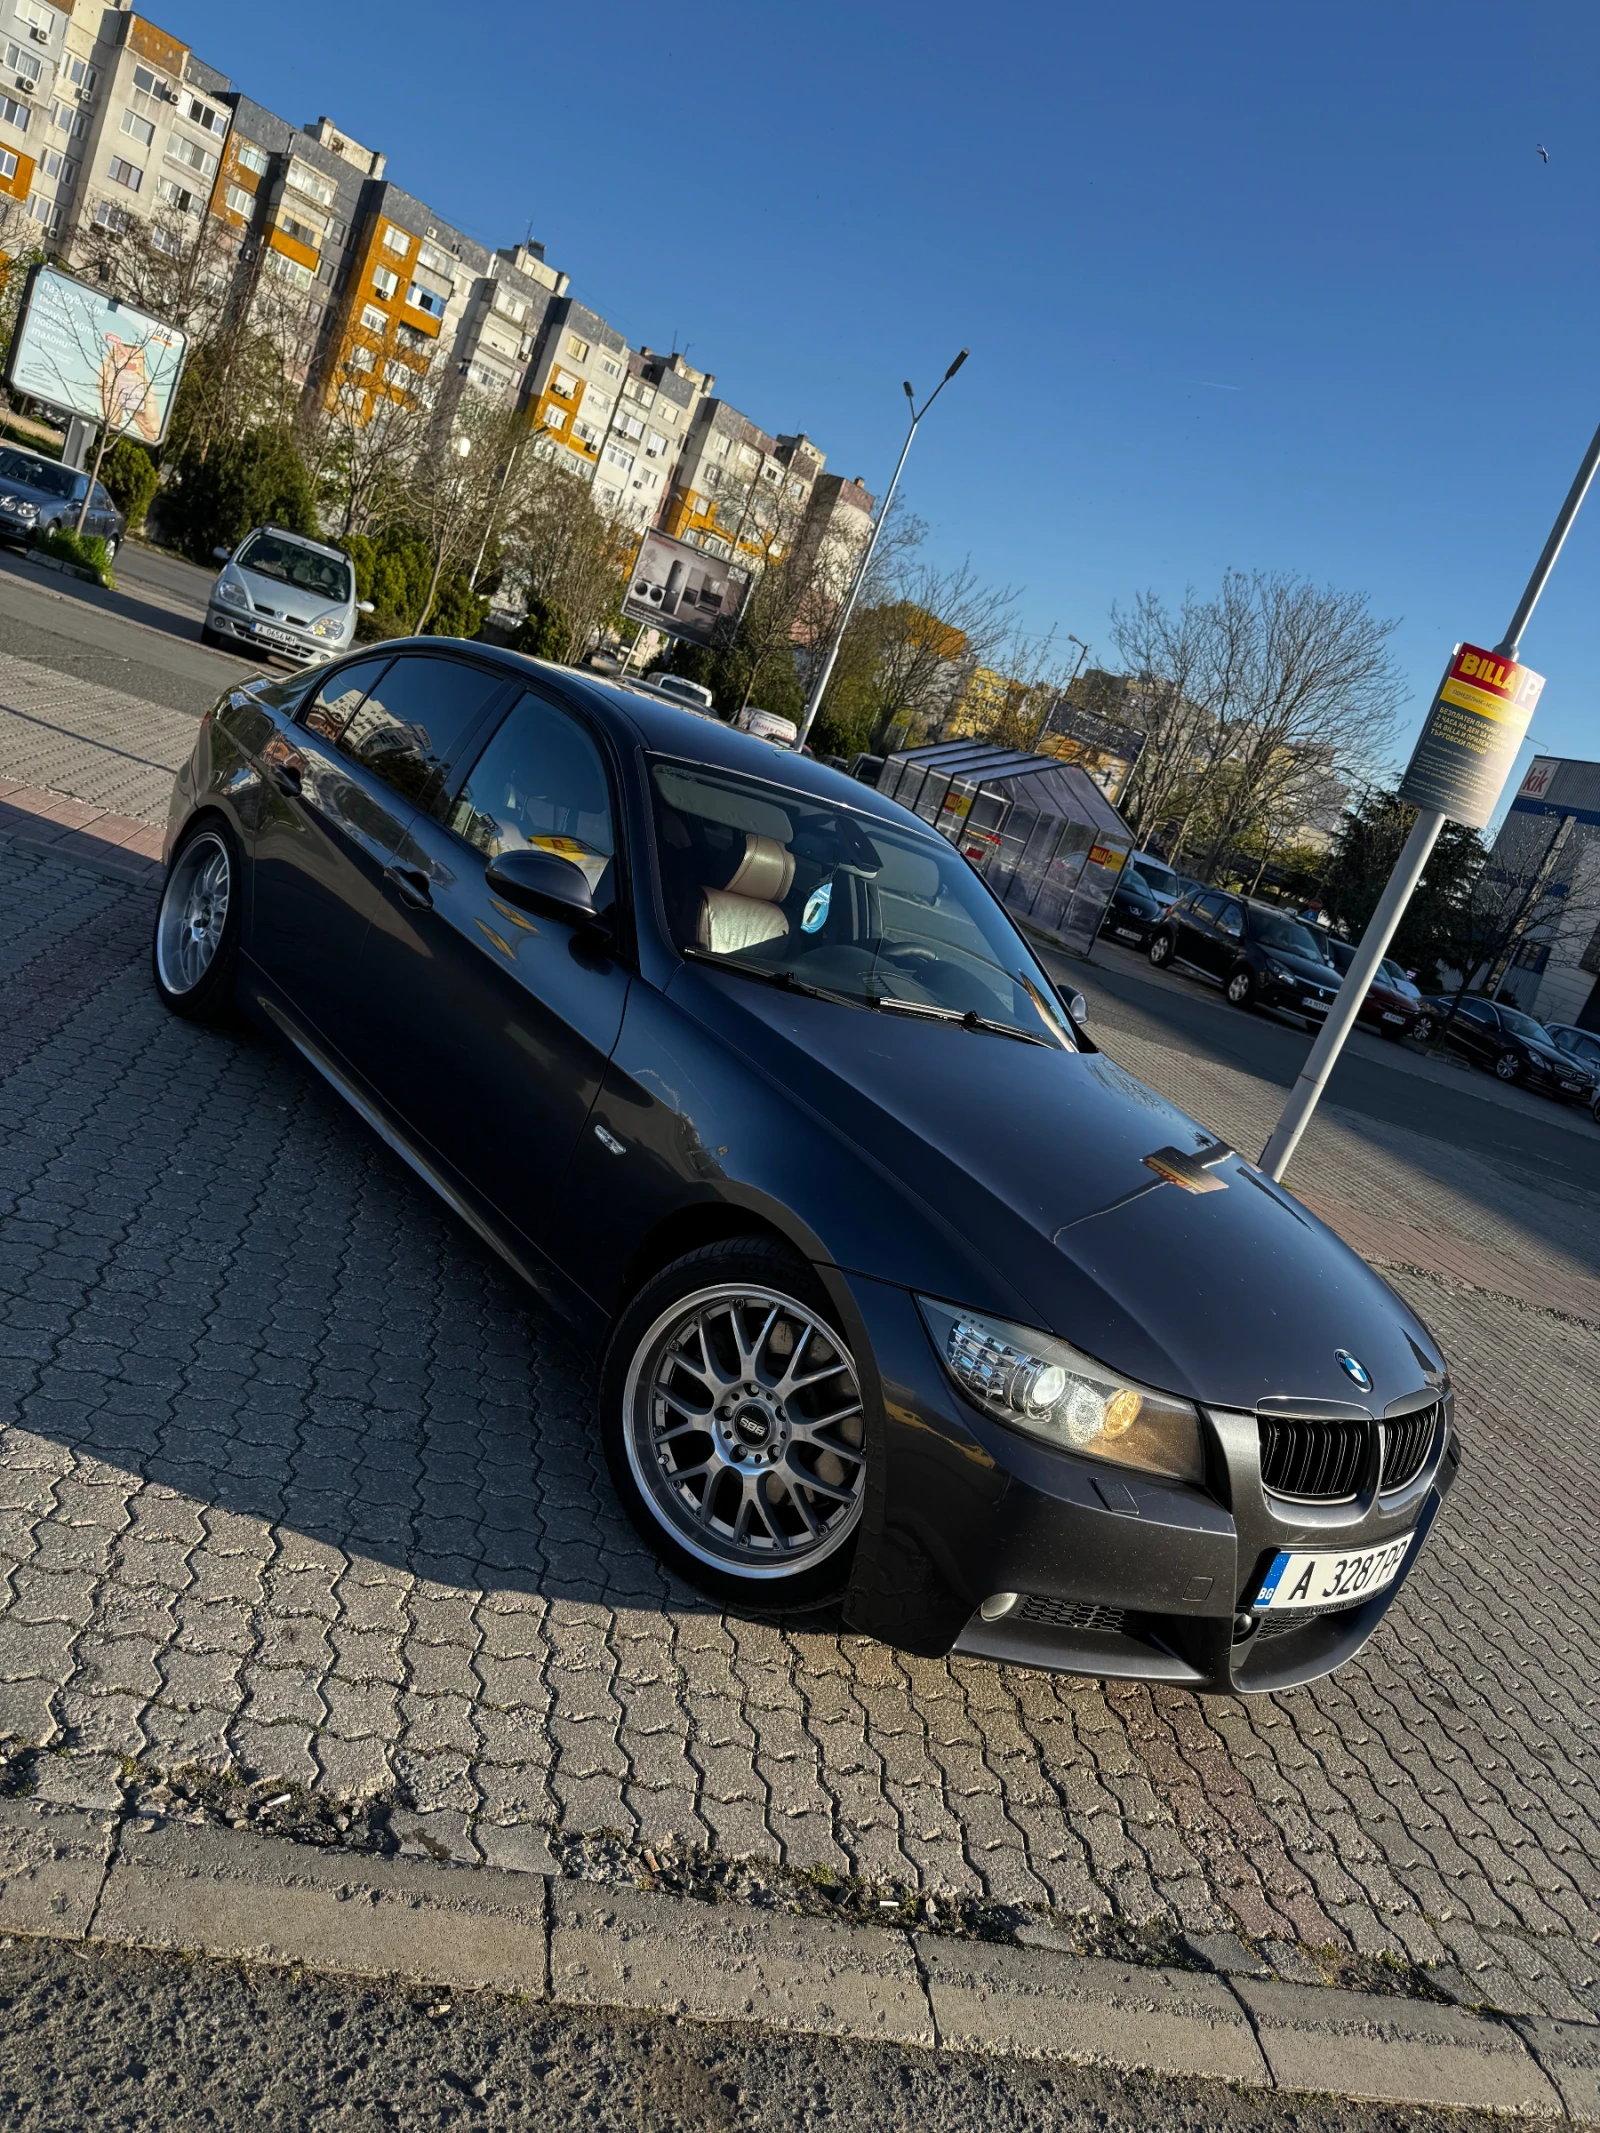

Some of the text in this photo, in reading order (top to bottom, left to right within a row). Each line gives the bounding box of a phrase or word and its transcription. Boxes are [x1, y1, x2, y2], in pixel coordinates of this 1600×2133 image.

[156, 328, 172, 341] dm
[1459, 652, 1517, 692] BILLA
[1521, 680, 1539, 702] P
[1439, 706, 1475, 724] БЕЗПЛАТЕН
[1432, 721, 1442, 729] НА
[1442, 725, 1460, 736] BILLA
[1440, 716, 1458, 727] ЧАСА
[1457, 722, 1467, 730] НА
[1466, 726, 1480, 735] ДЕН
[1430, 728, 1466, 746] ТЪРГОВСКИ
[1522, 765, 1549, 793] kik
[1288, 1561, 1316, 1600] A
[1257, 1588, 1273, 1600] BG
